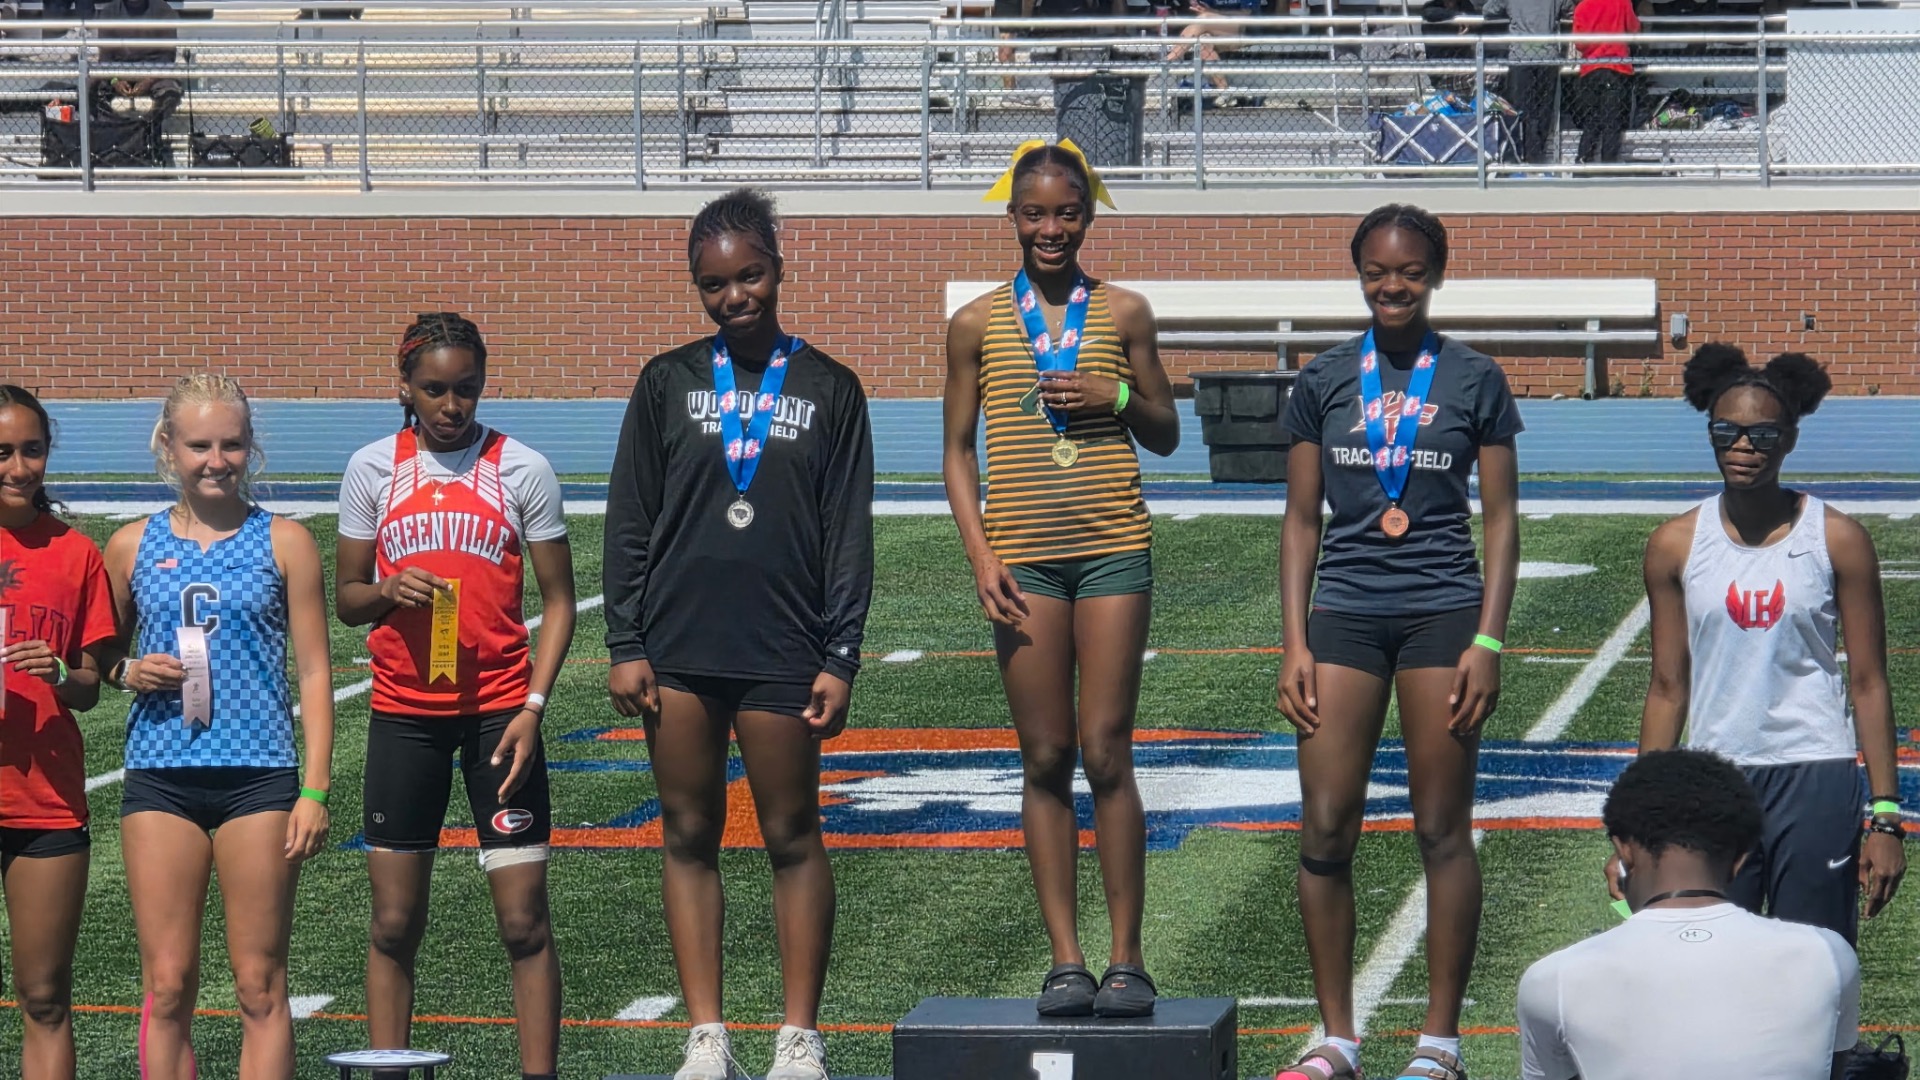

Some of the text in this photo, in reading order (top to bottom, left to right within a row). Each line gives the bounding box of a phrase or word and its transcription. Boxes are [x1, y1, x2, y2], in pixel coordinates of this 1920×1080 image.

[687, 390, 816, 430] WODONT
[770, 424, 798, 440] IELD
[381, 511, 511, 566] GREENVILLE
[181, 583, 220, 636] C
